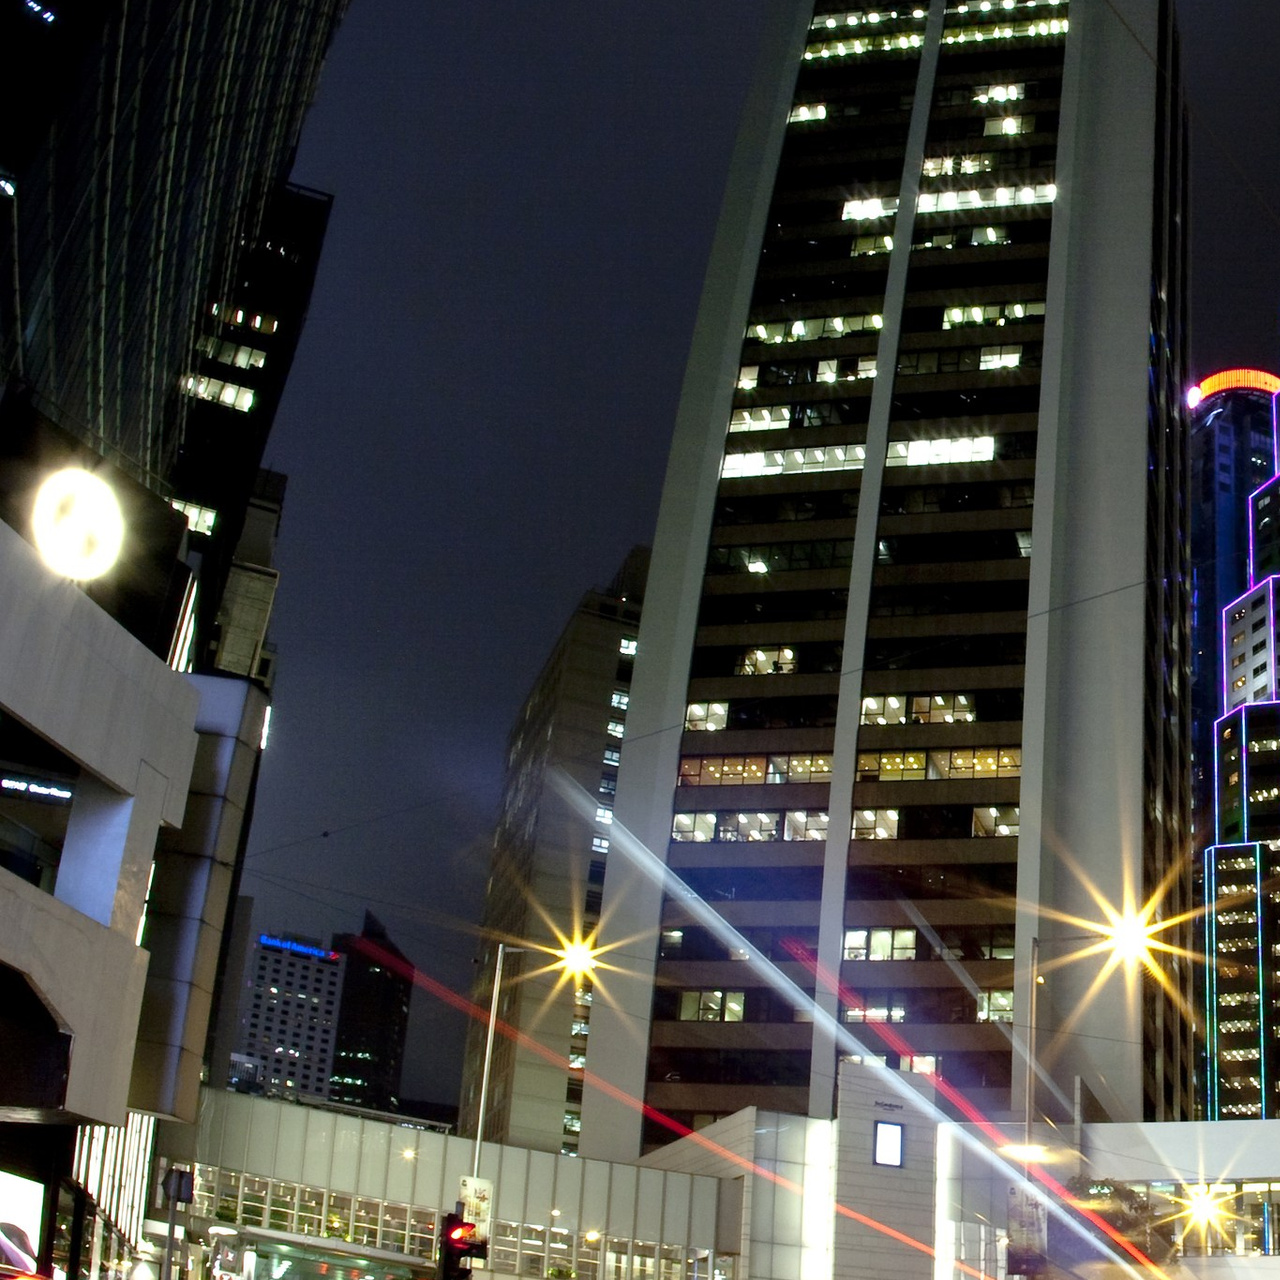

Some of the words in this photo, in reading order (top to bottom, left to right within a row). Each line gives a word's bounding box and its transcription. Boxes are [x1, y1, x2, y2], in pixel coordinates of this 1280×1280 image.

[260, 934, 281, 948] Bank
[281, 940, 291, 950] of
[291, 942, 325, 957] America
